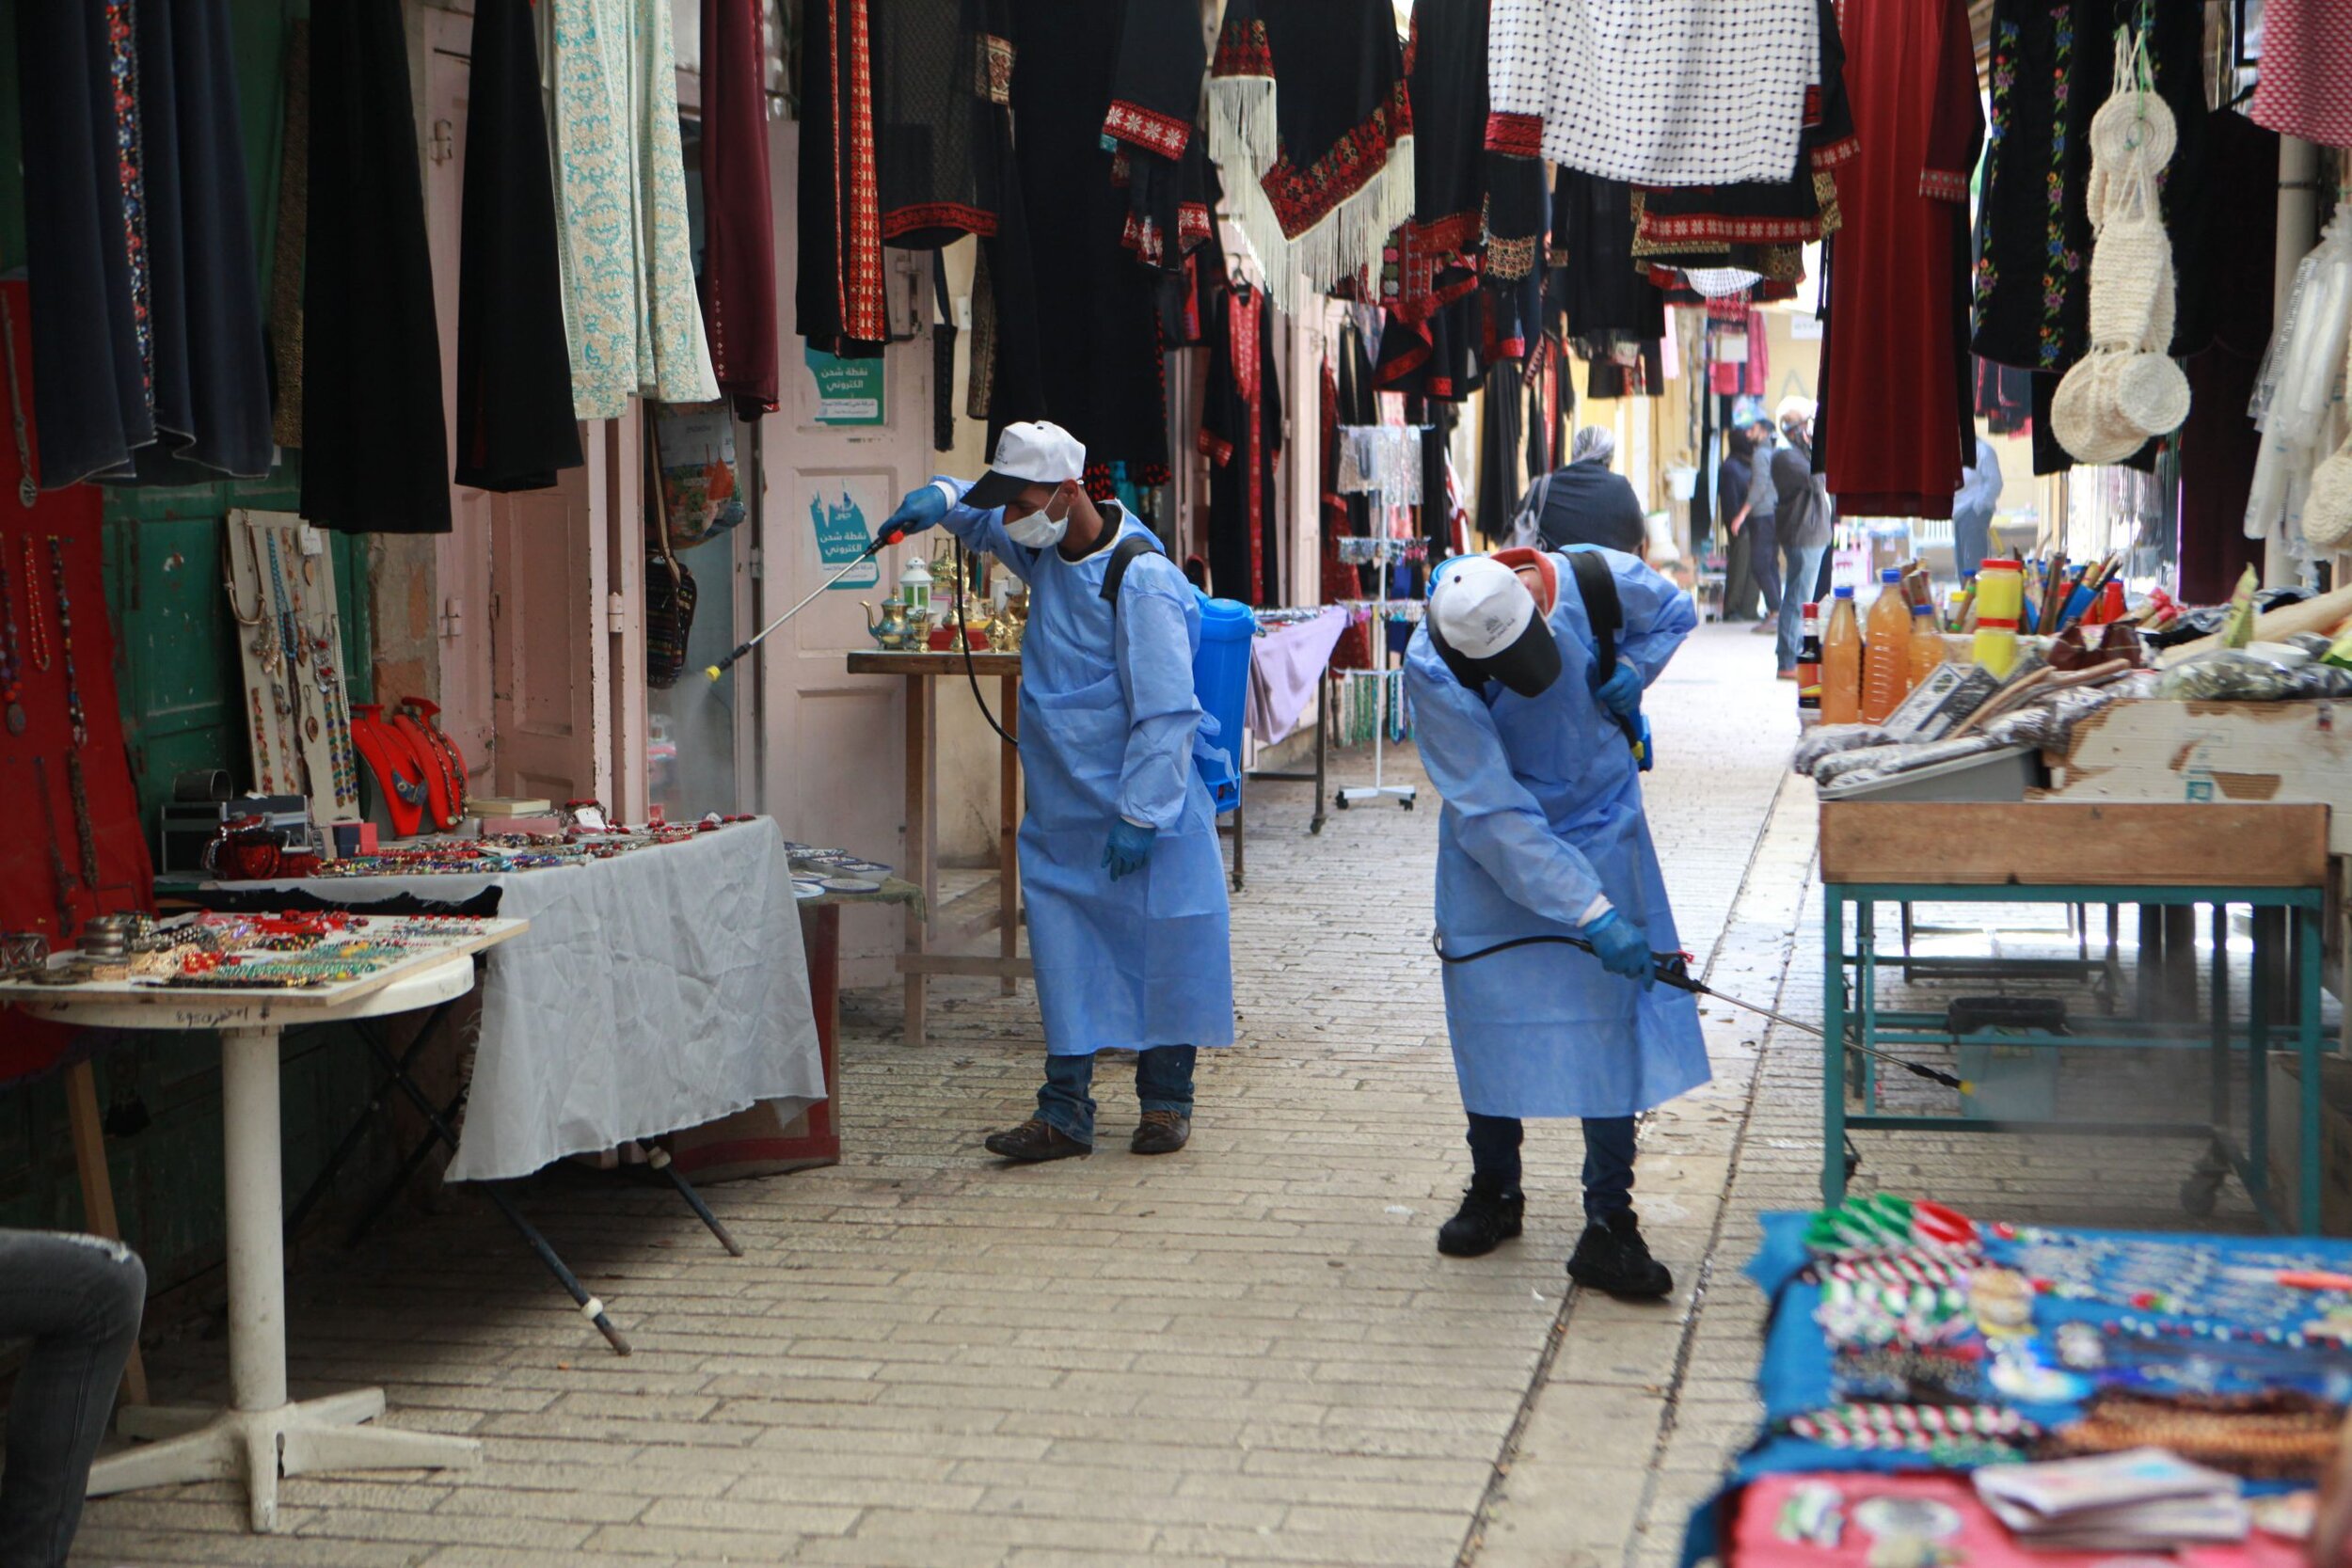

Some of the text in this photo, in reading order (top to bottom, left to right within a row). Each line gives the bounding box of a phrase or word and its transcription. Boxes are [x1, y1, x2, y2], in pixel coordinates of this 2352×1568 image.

[820, 367, 868, 377] نقطة شحن
[827, 379, 863, 391] الكتروني
[820, 531, 866, 542] نقطة شحن
[825, 544, 862, 555] الكتروني
